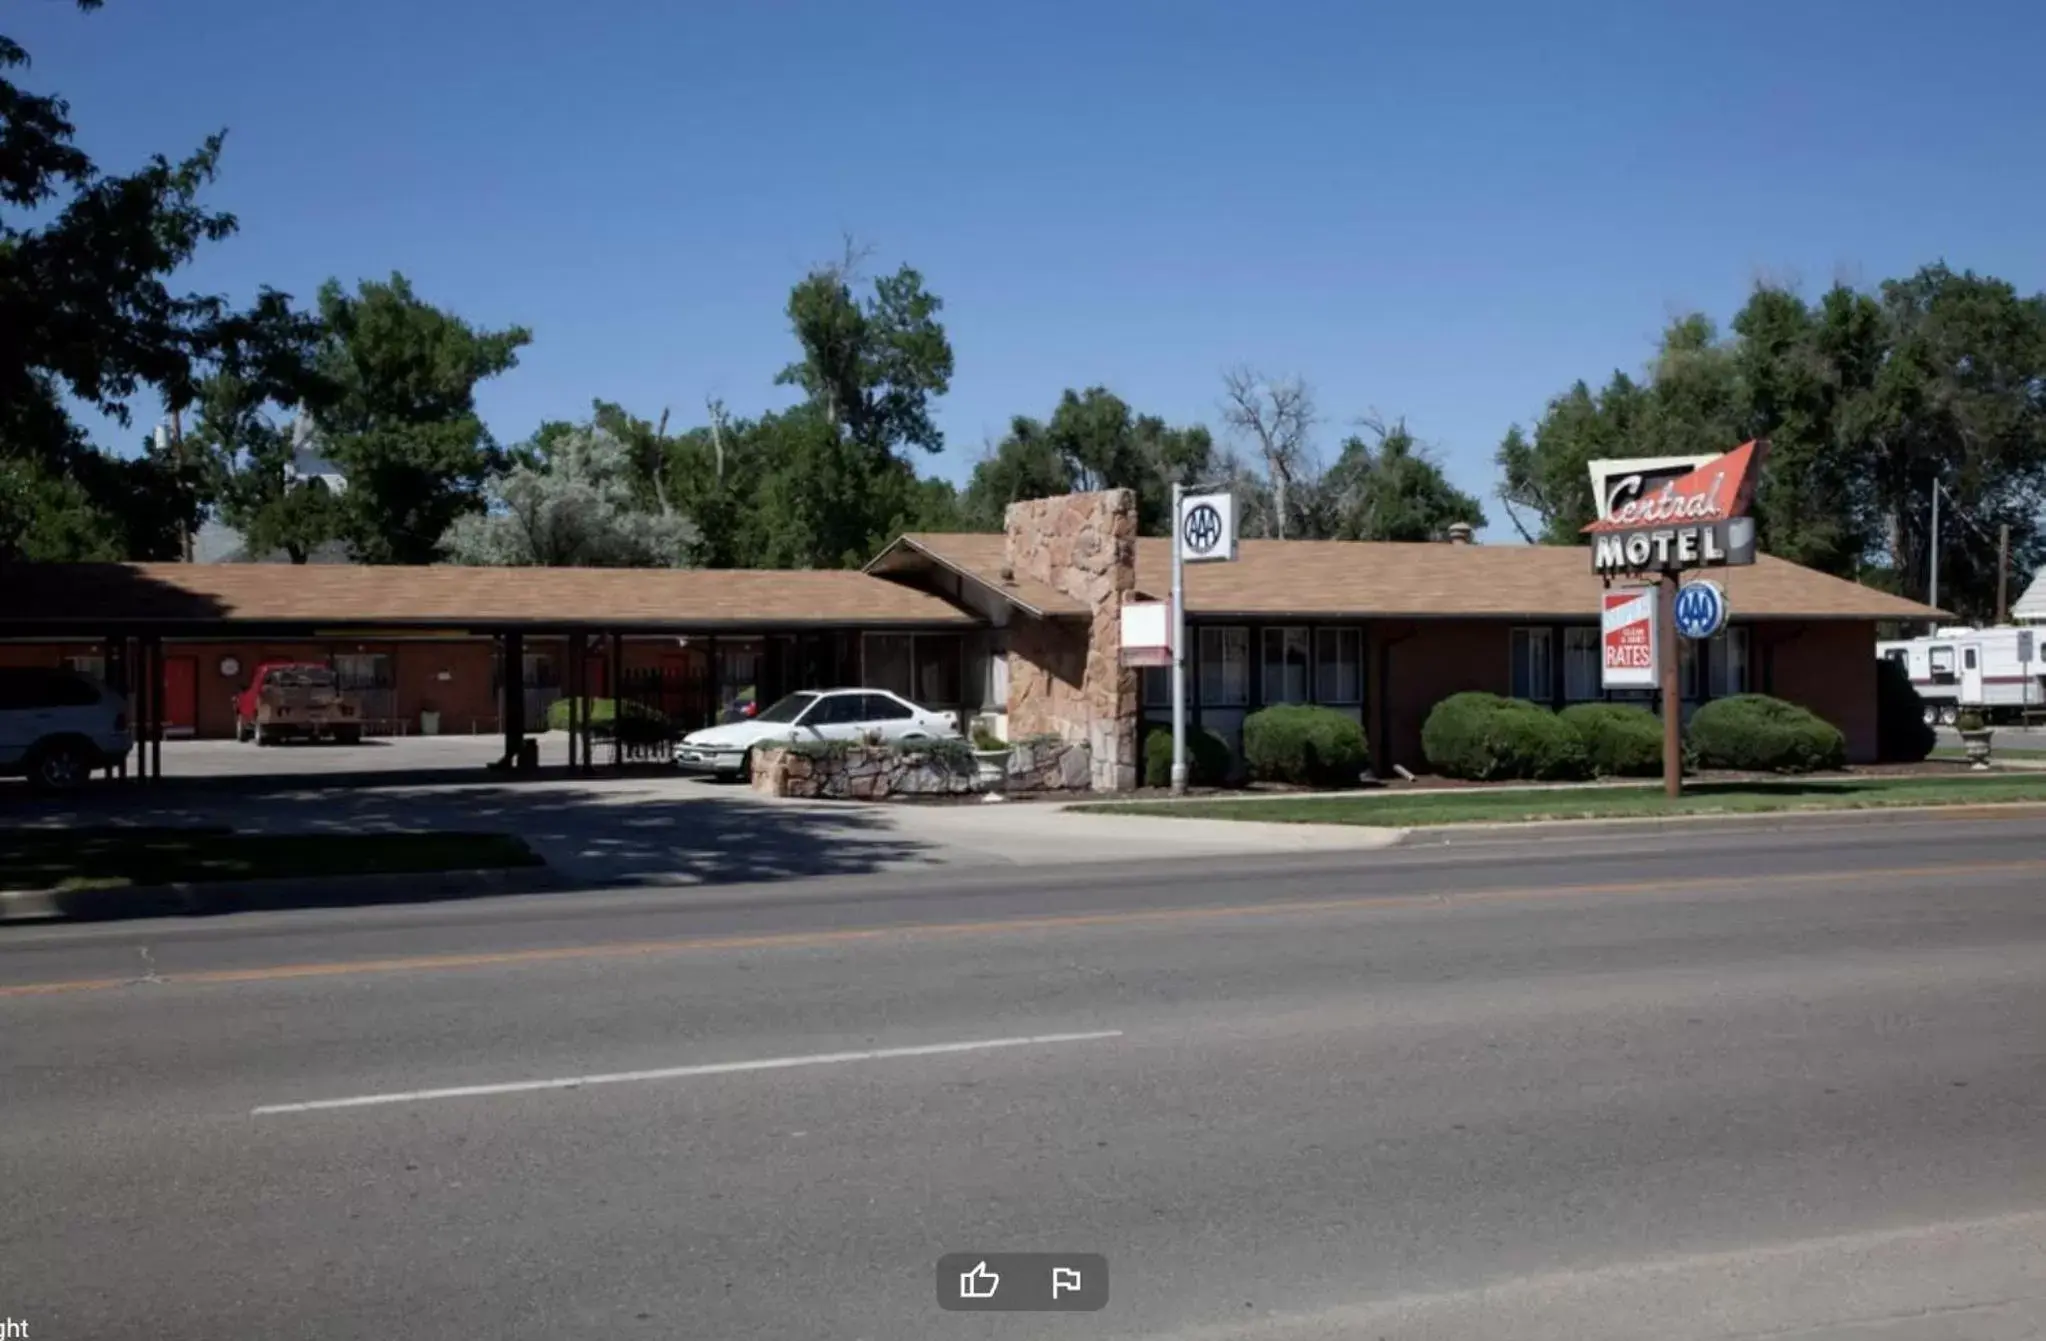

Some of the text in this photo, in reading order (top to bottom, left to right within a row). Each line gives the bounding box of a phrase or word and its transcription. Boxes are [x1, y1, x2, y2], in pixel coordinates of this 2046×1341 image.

[1607, 473, 1724, 523] Central
[1595, 526, 1725, 568] MOTEL
[1606, 645, 1650, 666] RATES
